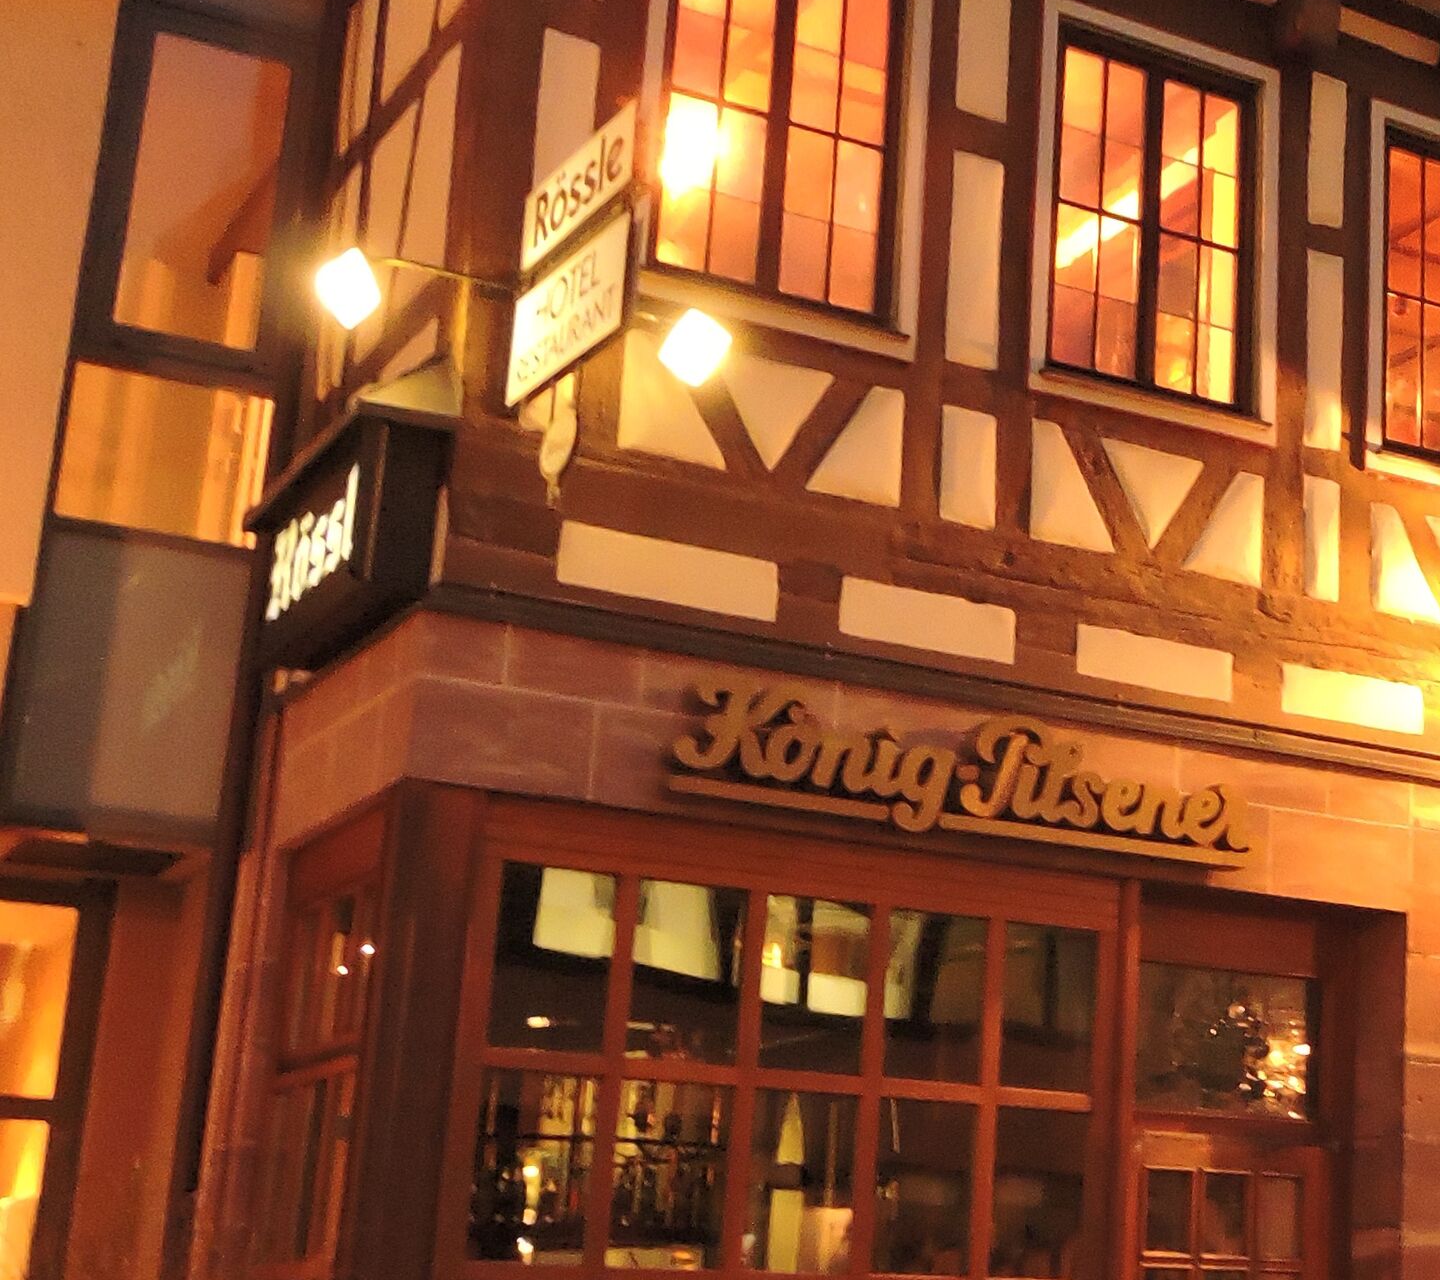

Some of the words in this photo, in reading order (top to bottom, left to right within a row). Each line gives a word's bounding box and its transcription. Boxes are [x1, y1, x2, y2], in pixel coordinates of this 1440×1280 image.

[533, 135, 625, 249] Rössle
[672, 680, 956, 831] König
[959, 720, 1250, 852] Pilsener
